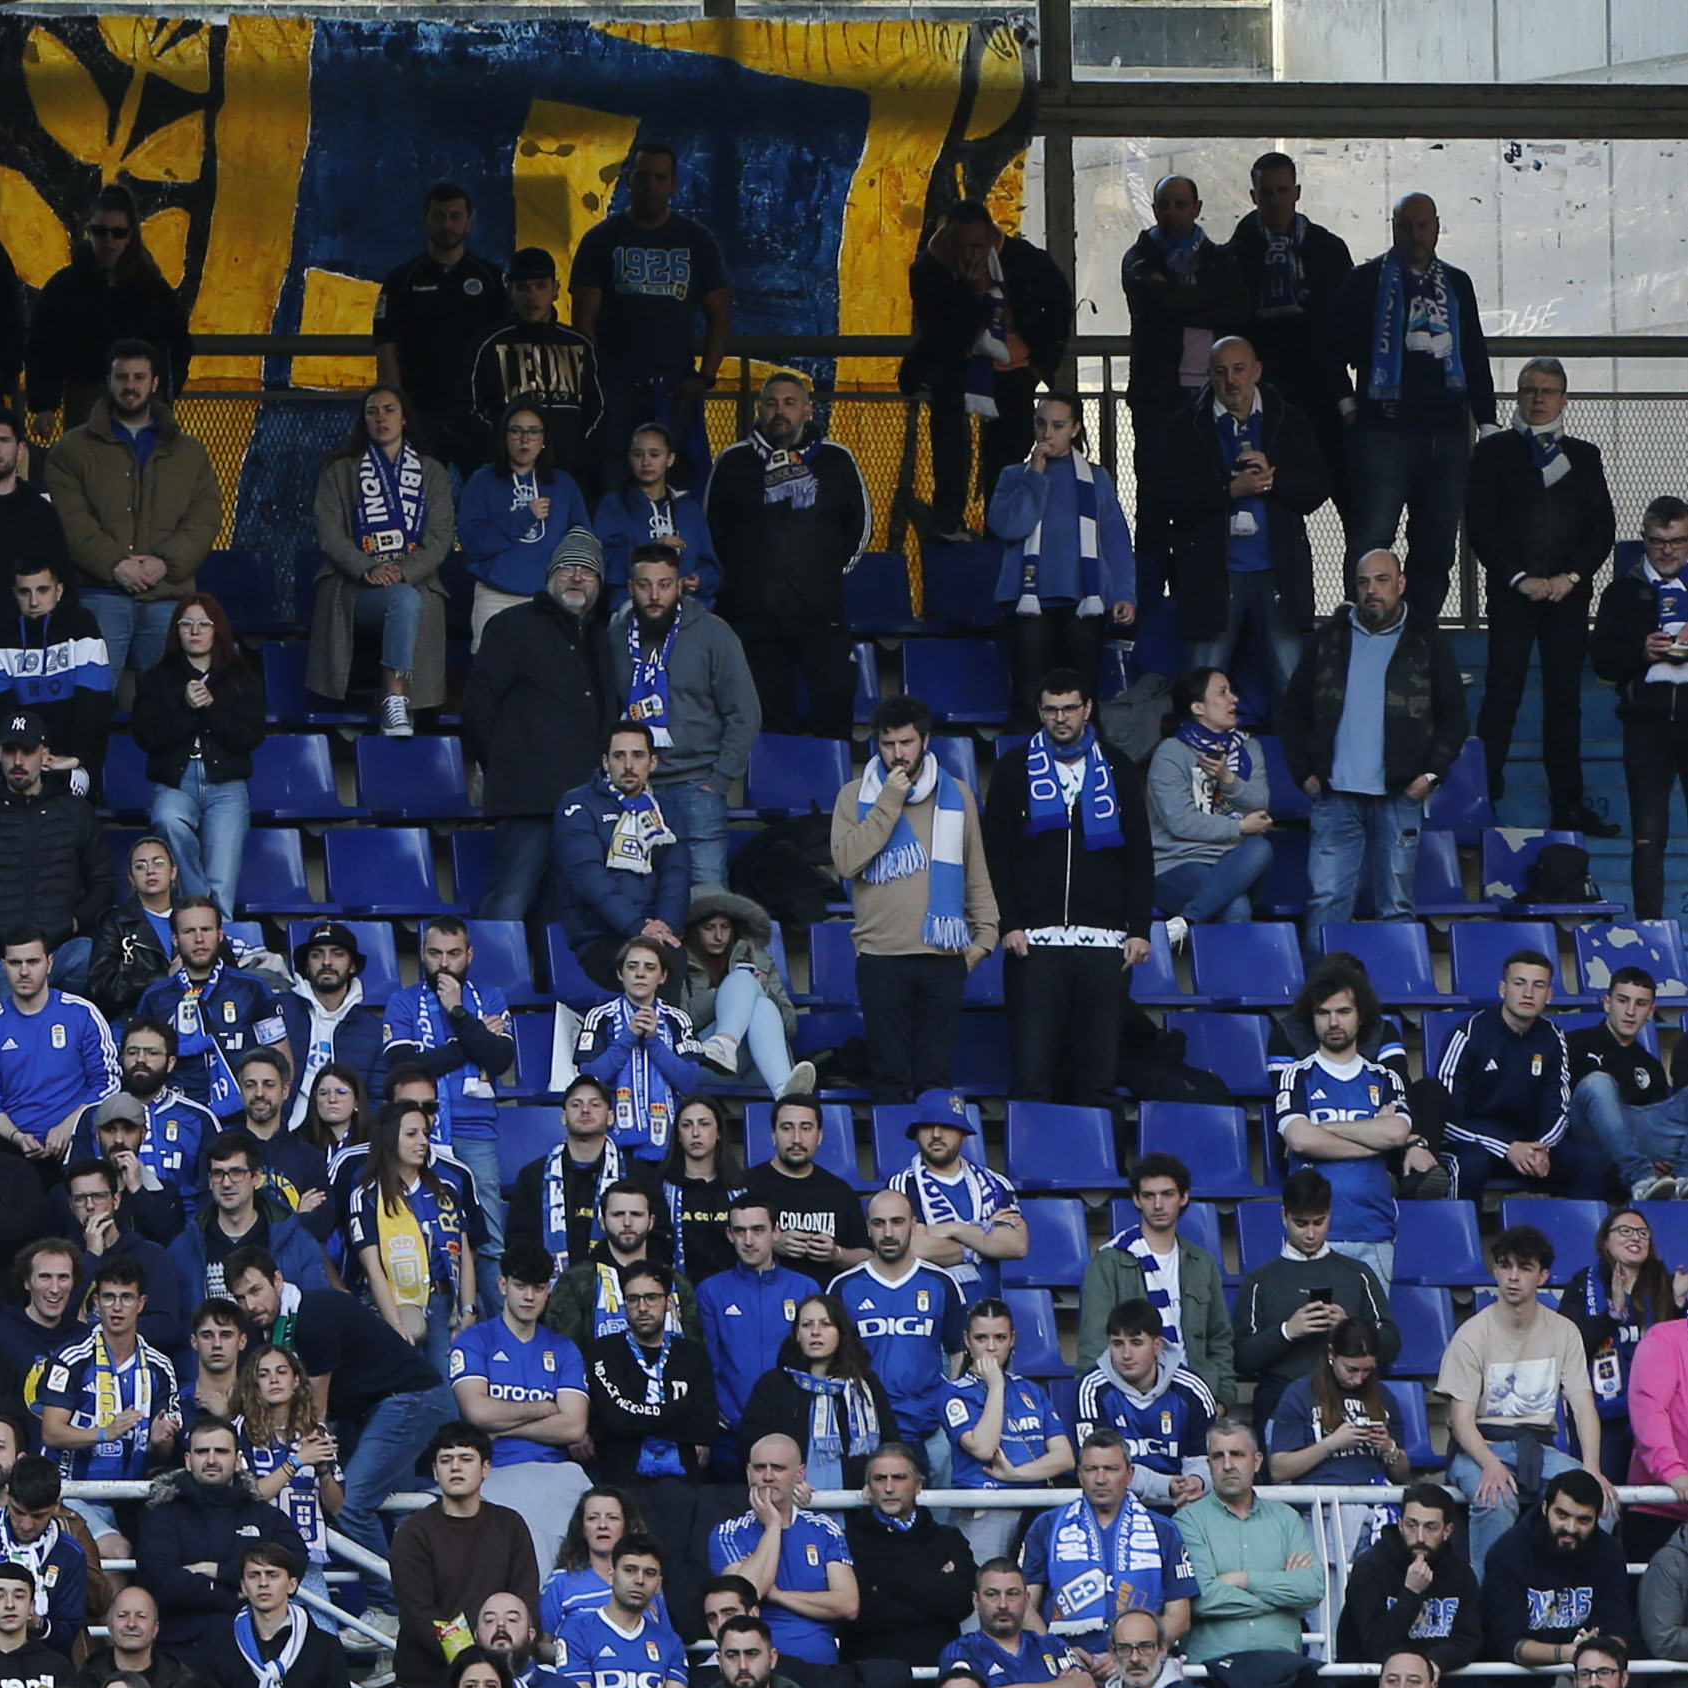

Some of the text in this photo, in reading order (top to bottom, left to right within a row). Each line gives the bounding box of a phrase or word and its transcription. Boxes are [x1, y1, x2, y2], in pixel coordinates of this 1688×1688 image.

[613, 247, 690, 288] 1926
[18, 650, 70, 675] 1926
[778, 1211, 836, 1238] COLONIA
[856, 1317, 936, 1339] DIGI
